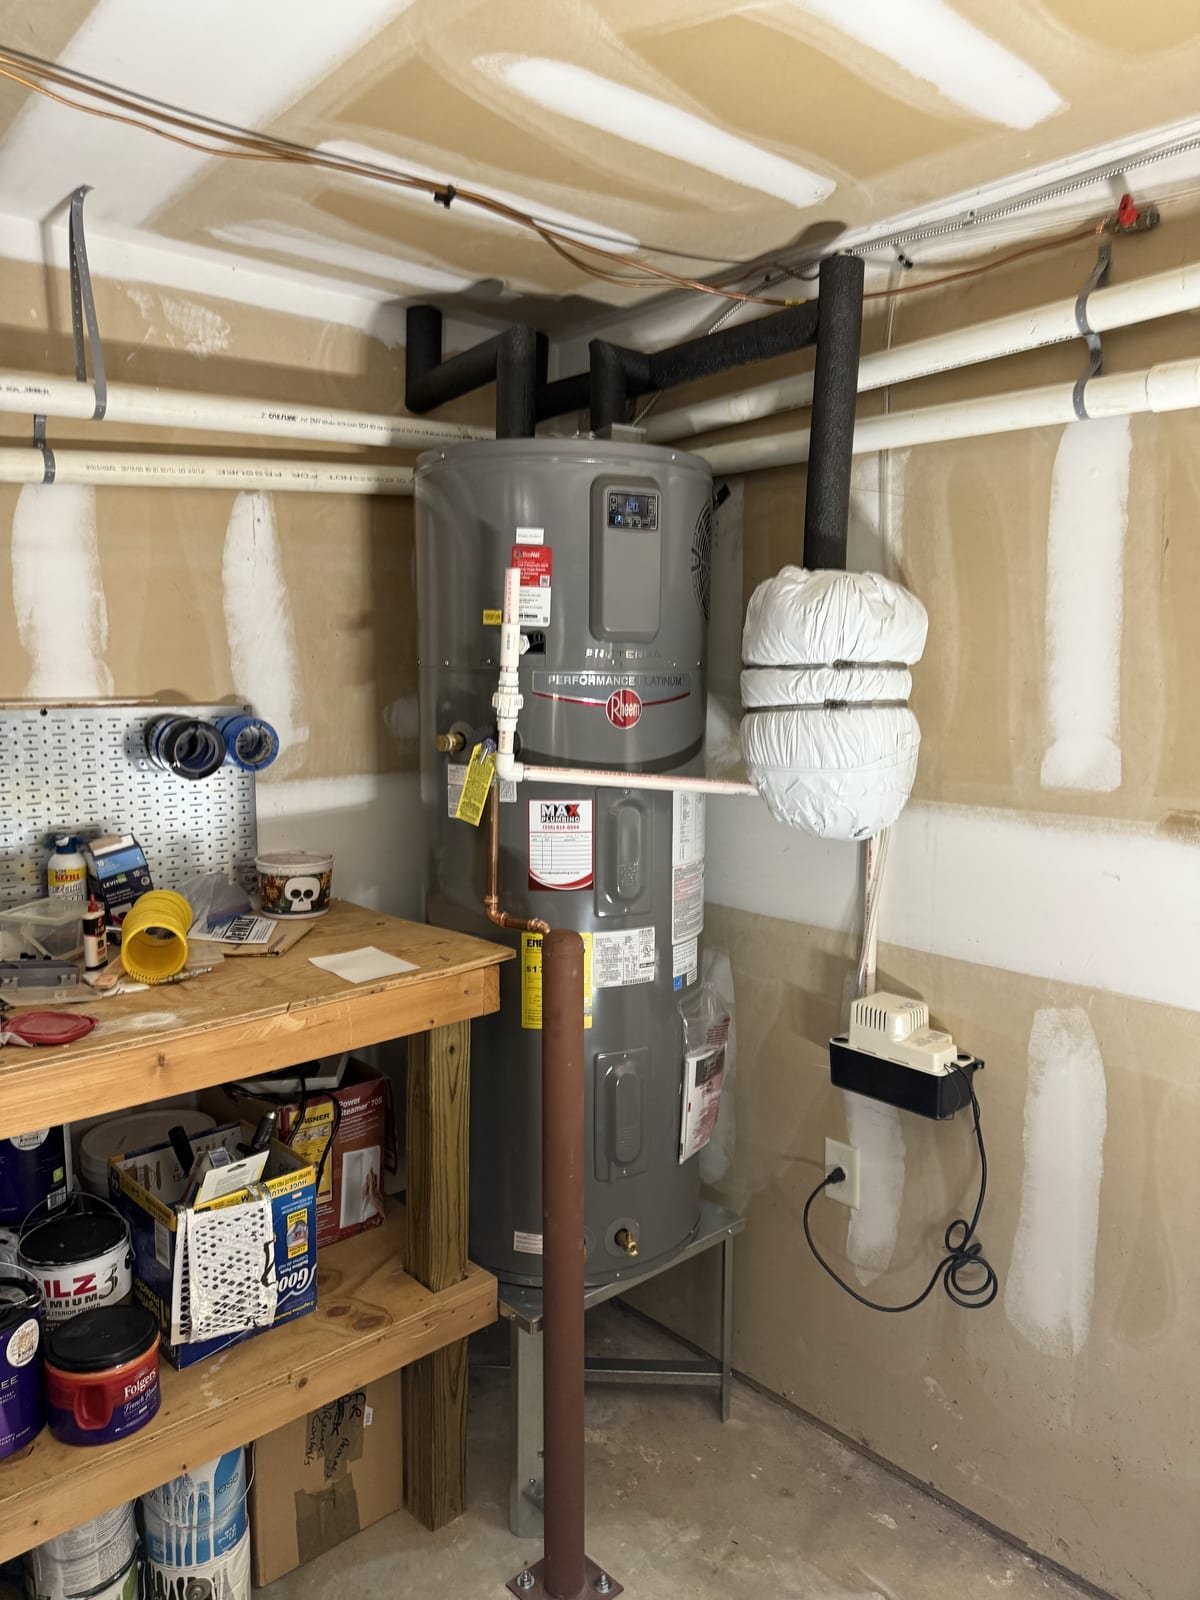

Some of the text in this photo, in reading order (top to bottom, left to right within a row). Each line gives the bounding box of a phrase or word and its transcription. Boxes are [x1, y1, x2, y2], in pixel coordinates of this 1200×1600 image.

[215, 468, 283, 479] PRESSURE
[291, 472, 318, 480] FOR
[548, 674, 683, 688] PERFORMANCE LATINUM
[611, 690, 640, 723] Rheem
[541, 804, 580, 818] MAX
[541, 816, 580, 824] PLUMBING
[339, 1096, 361, 1108] Power
[302, 1112, 331, 1125] AGNER
[290, 1180, 307, 1190] HUGE
[271, 1187, 289, 1197] VALU
[43, 1271, 97, 1298] ILZ
[277, 1267, 309, 1293] Goo
[124, 1367, 156, 1399] Folgers
